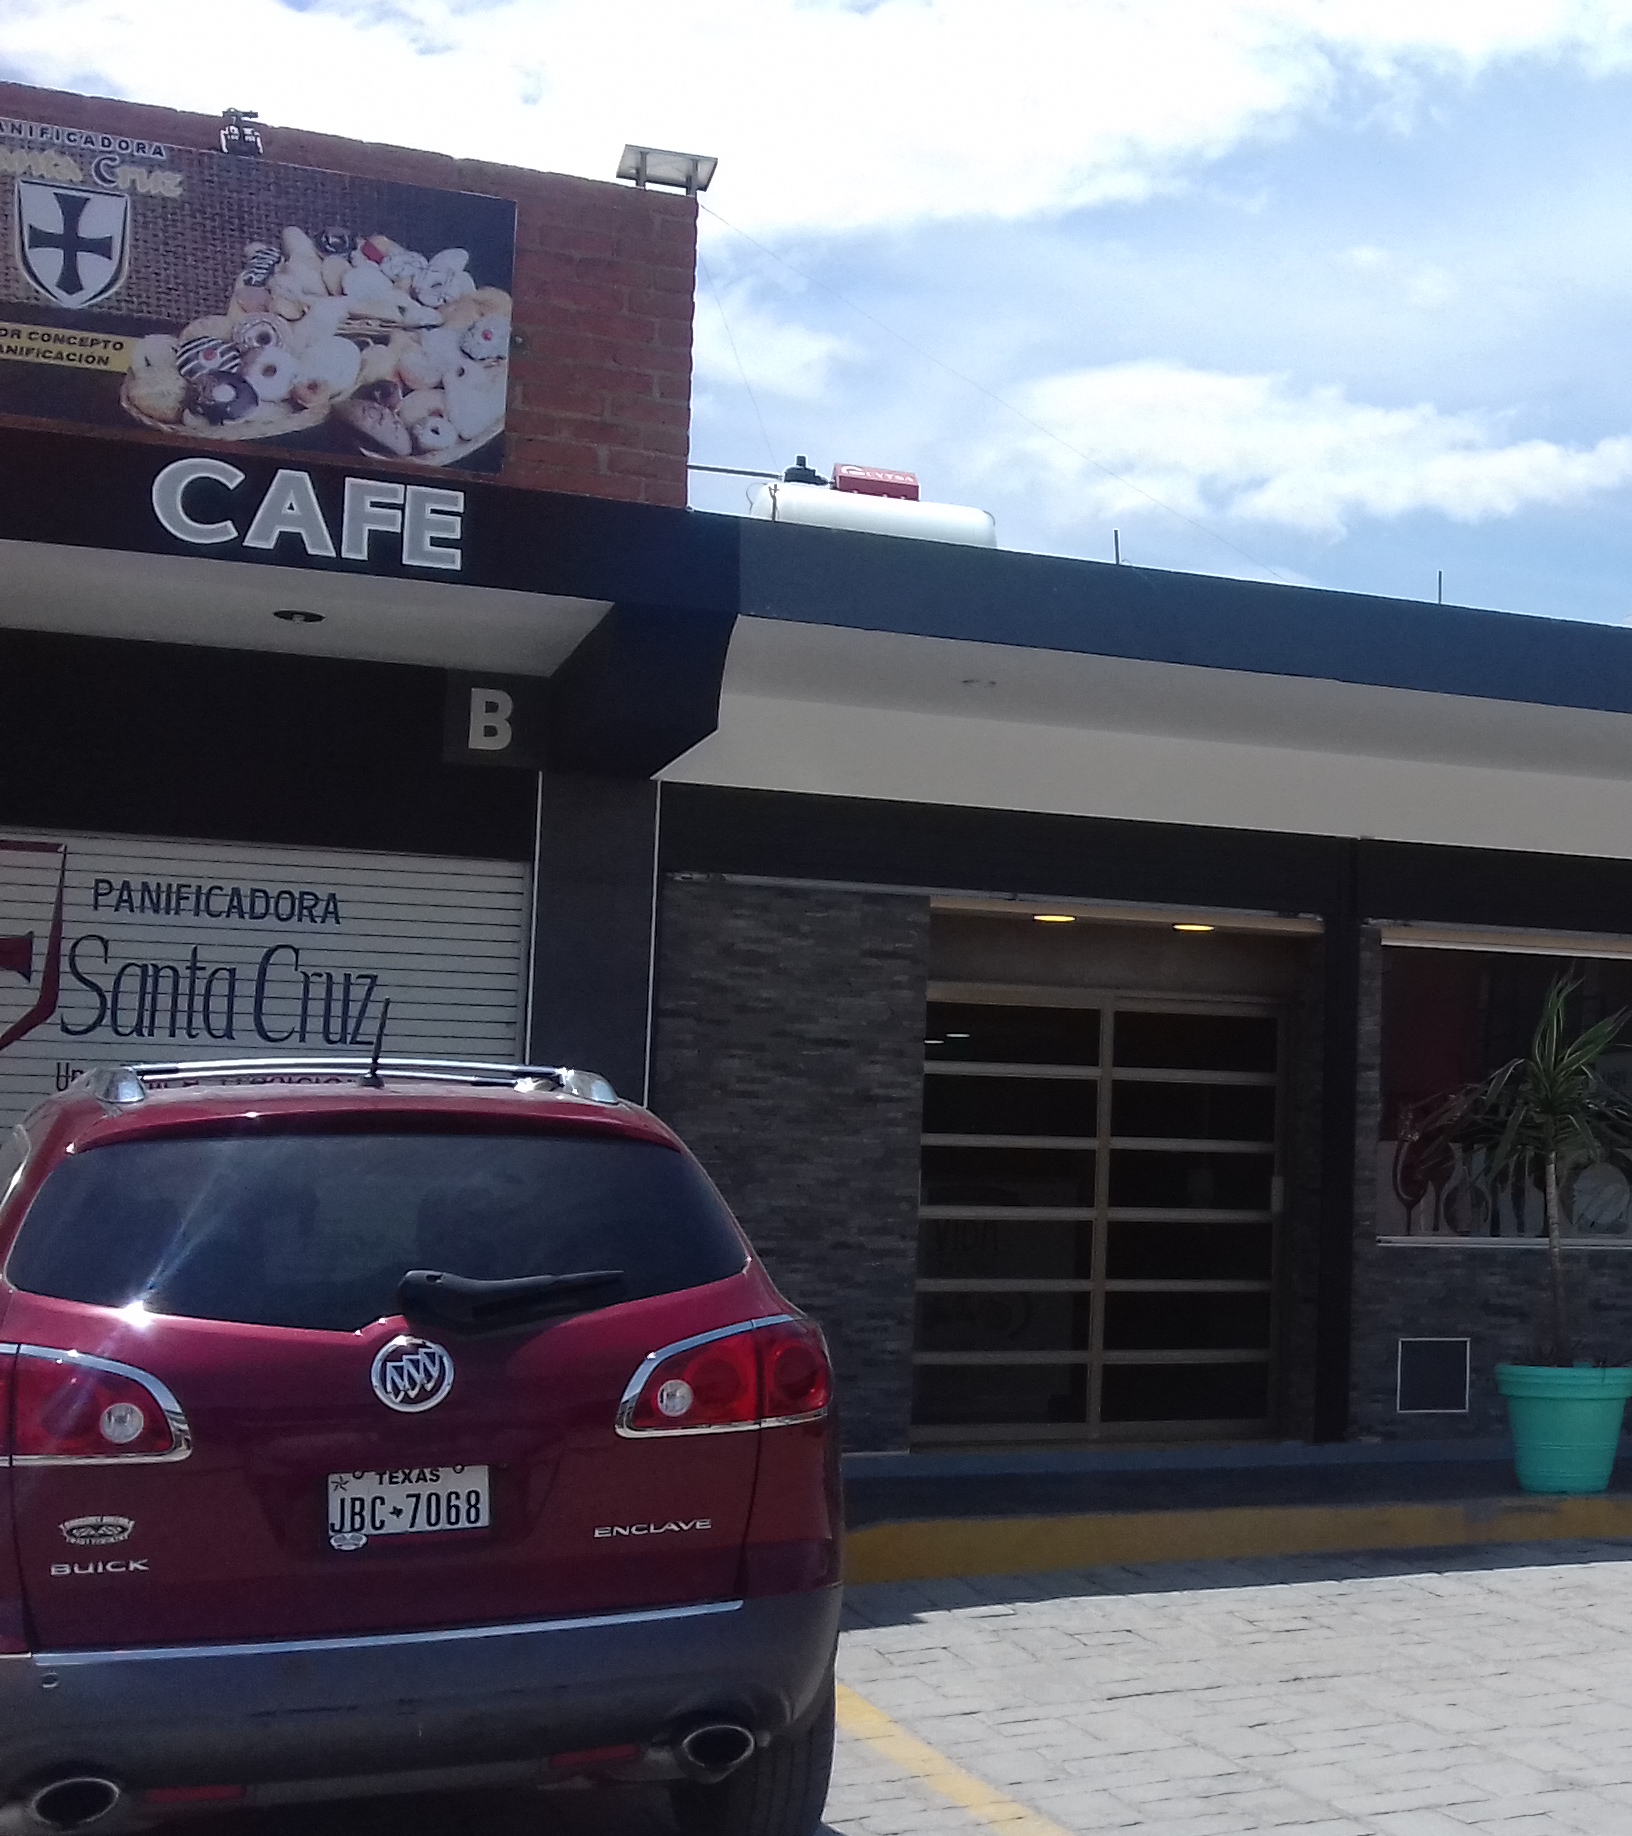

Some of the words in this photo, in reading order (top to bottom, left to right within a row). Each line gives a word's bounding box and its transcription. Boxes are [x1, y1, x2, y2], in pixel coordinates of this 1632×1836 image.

[28, 331, 124, 351] CONCEPTO
[151, 457, 466, 572] CAFE
[468, 687, 514, 751] B
[93, 877, 341, 926] PANIFICADORA
[61, 934, 236, 1040] Santa
[254, 943, 379, 1047] Cruz
[375, 1468, 441, 1485] TEXAS
[594, 1519, 712, 1538] ENCLAVE
[50, 1558, 150, 1576] BUICK
